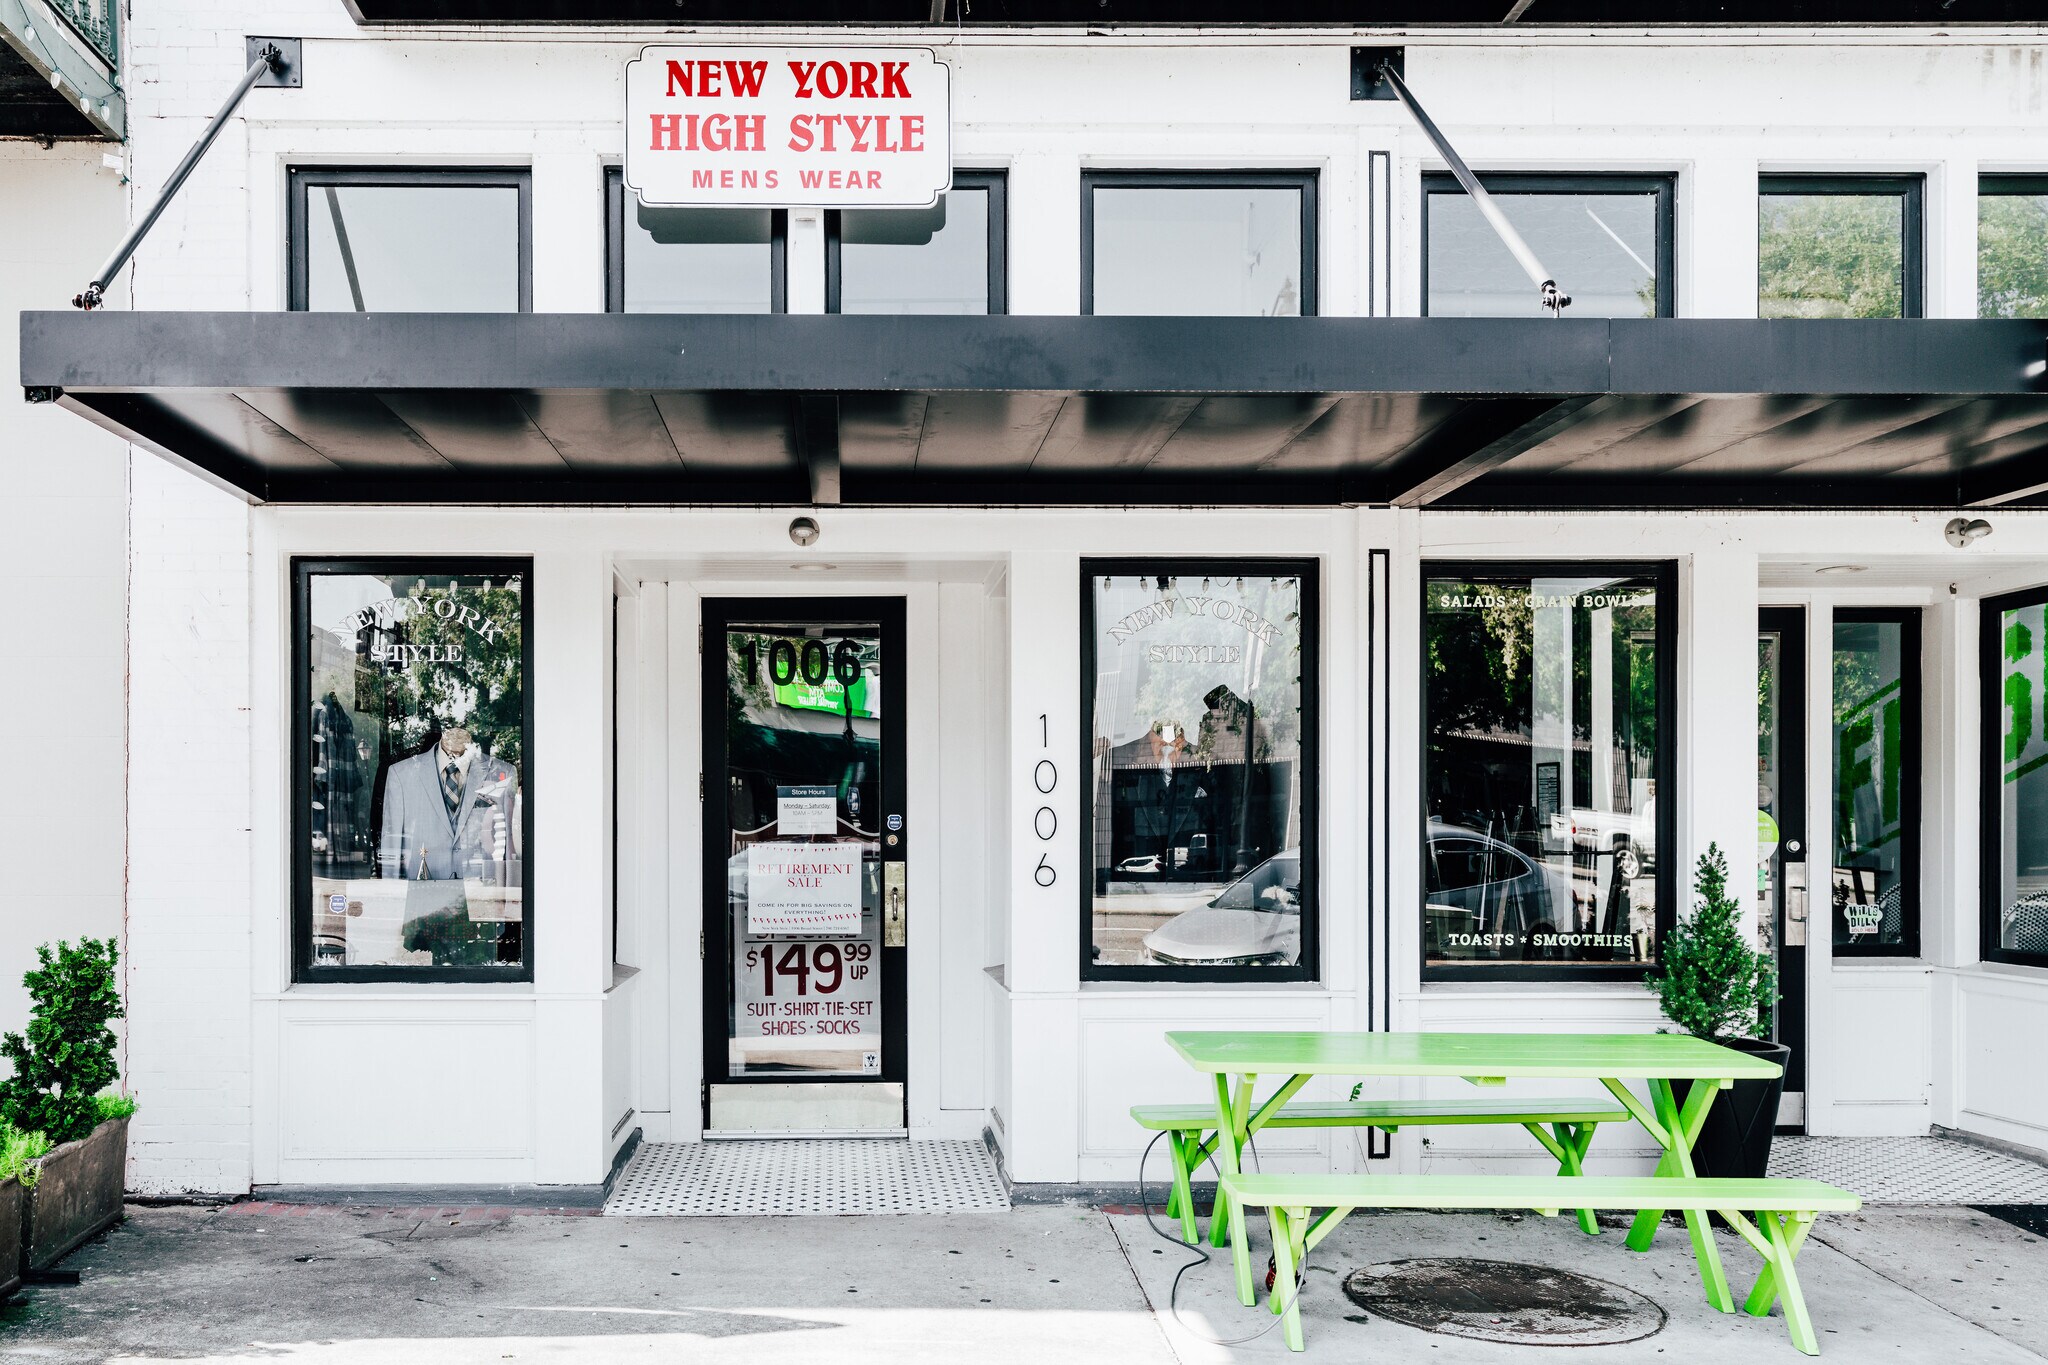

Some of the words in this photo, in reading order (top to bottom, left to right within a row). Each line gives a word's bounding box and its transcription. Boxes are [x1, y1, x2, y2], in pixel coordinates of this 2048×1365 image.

[666, 60, 768, 98] NEW
[787, 60, 912, 99] YORK
[650, 113, 766, 152] HIGH
[788, 113, 924, 153] STYLE
[692, 170, 779, 189] MENS
[799, 170, 882, 189] WEAR
[1440, 595, 1506, 608] SALADS
[1524, 595, 1577, 608] GRAIN
[1583, 595, 1641, 608] BOWLS
[328, 597, 398, 646] NEW
[410, 596, 504, 646] YORK
[1106, 597, 1178, 646] NEW
[1186, 597, 1284, 647] YORK
[370, 644, 463, 663] STYLE
[738, 639, 862, 686] 1006
[1149, 645, 1241, 664] STYLE
[1034, 713, 1057, 887] 1006
[757, 863, 854, 874] RETIREMENT
[787, 877, 823, 888] SALE
[1448, 933, 1514, 946] TOASTS
[1533, 933, 1633, 947] SMOOTHIES
[850, 965, 869, 980] UP
[746, 1002, 777, 1016] SUIT
[784, 1002, 820, 1016] SHIRT
[762, 1020, 807, 1036] SHOES
[816, 1020, 861, 1035] SOCKS
